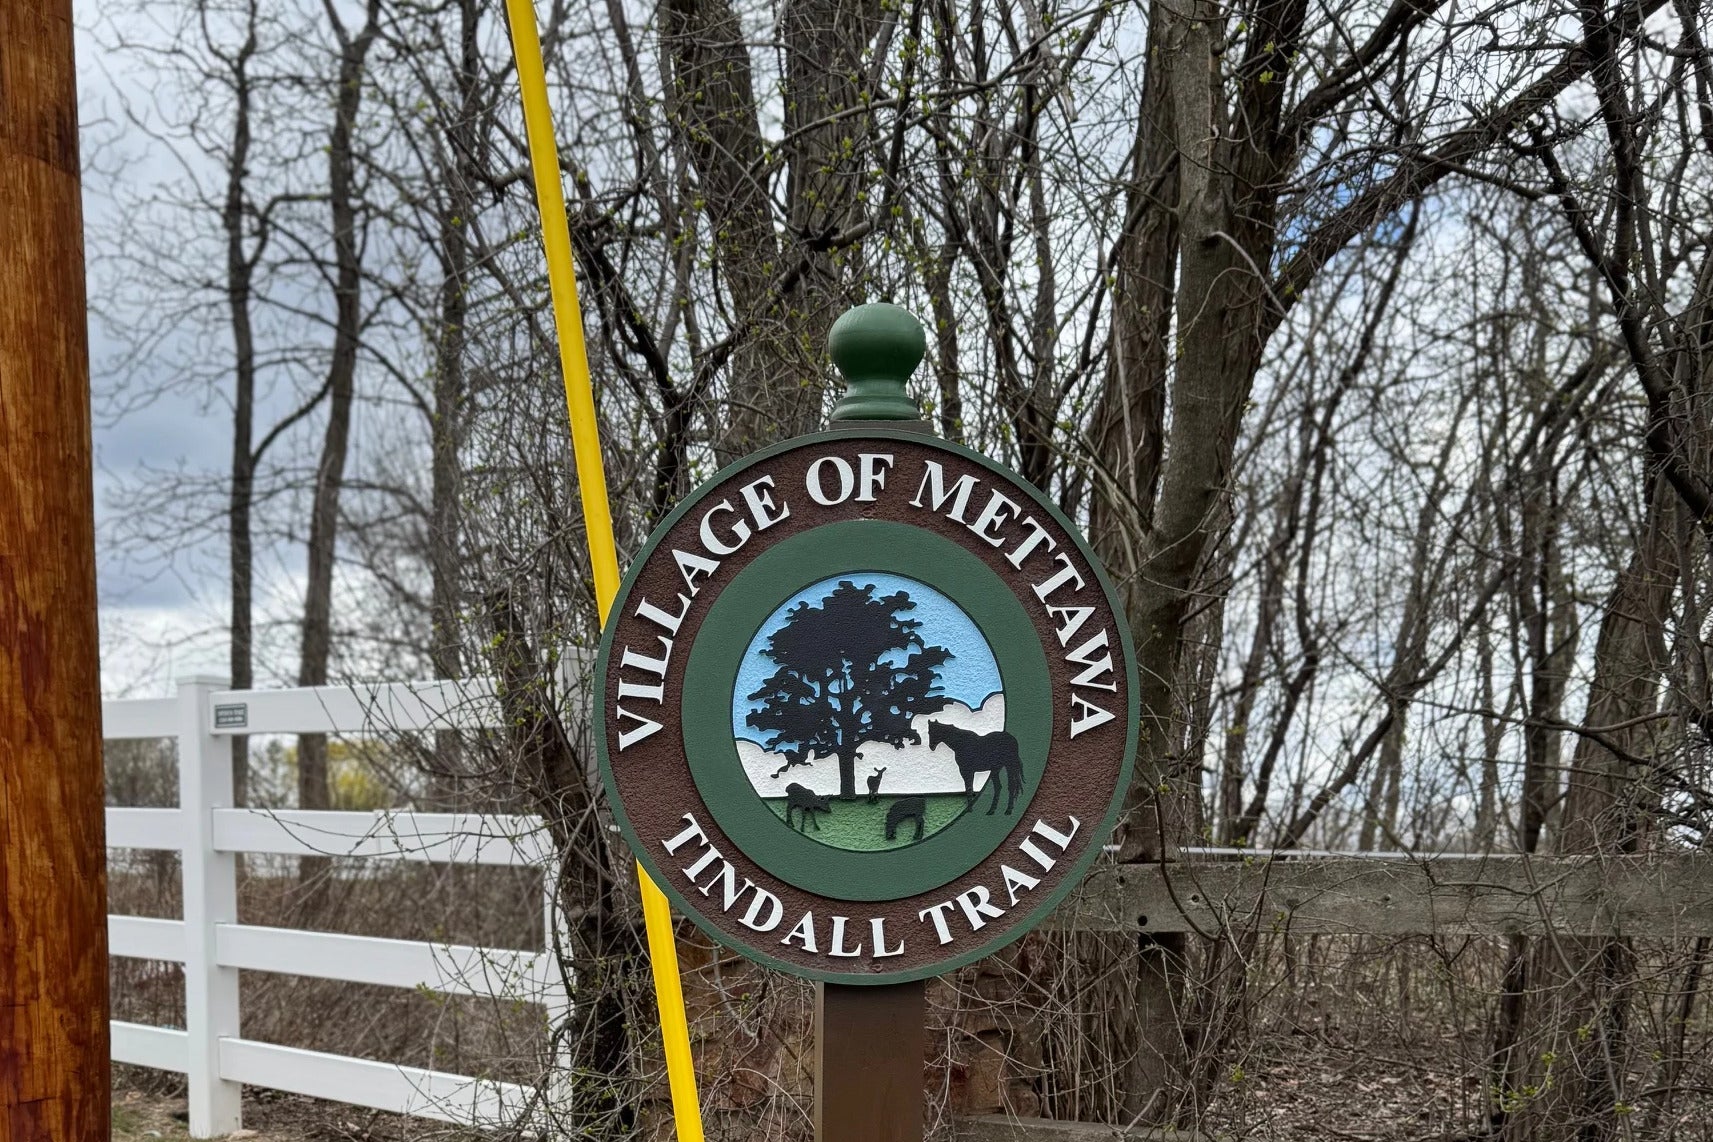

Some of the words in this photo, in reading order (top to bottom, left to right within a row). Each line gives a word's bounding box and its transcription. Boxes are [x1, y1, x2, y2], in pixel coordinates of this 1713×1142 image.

[616, 474, 790, 752] VILLAGE
[805, 453, 894, 506] OF
[908, 459, 1117, 740] METTAWA
[661, 812, 905, 958] TINDALL
[918, 815, 1081, 946] TRAIL
